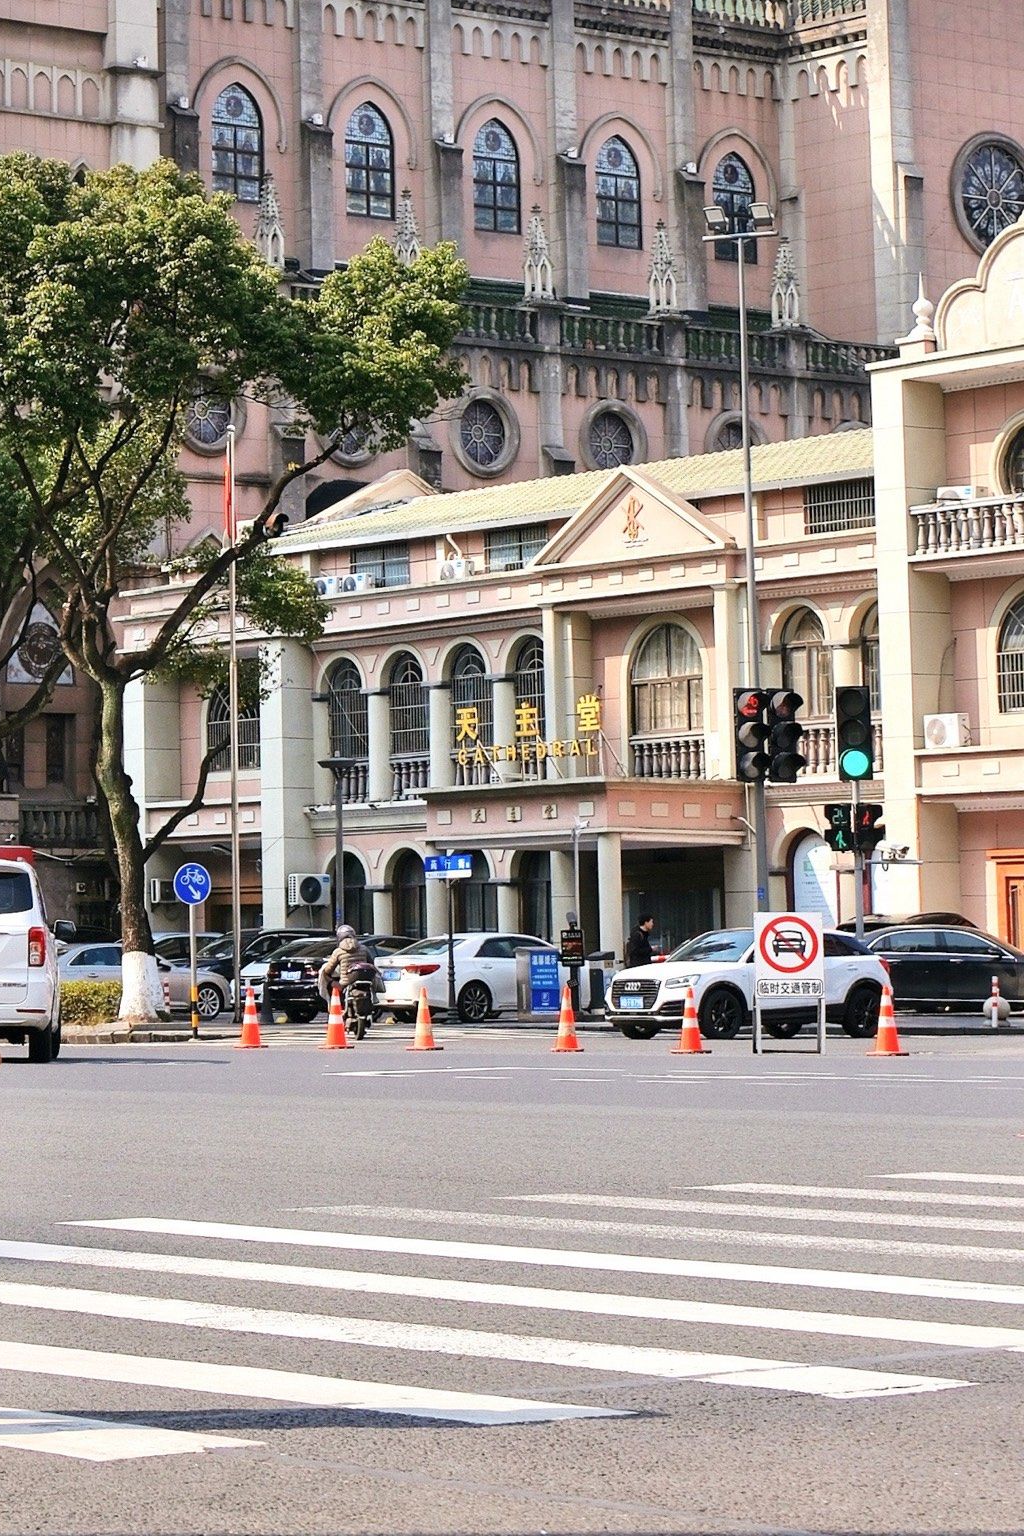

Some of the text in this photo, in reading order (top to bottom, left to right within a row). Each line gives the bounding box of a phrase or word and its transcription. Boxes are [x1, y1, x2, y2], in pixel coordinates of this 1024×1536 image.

[456, 694, 601, 742] 天主堂
[458, 738, 598, 766] CATHEDRAL
[759, 982, 821, 994] 临时交通管制
